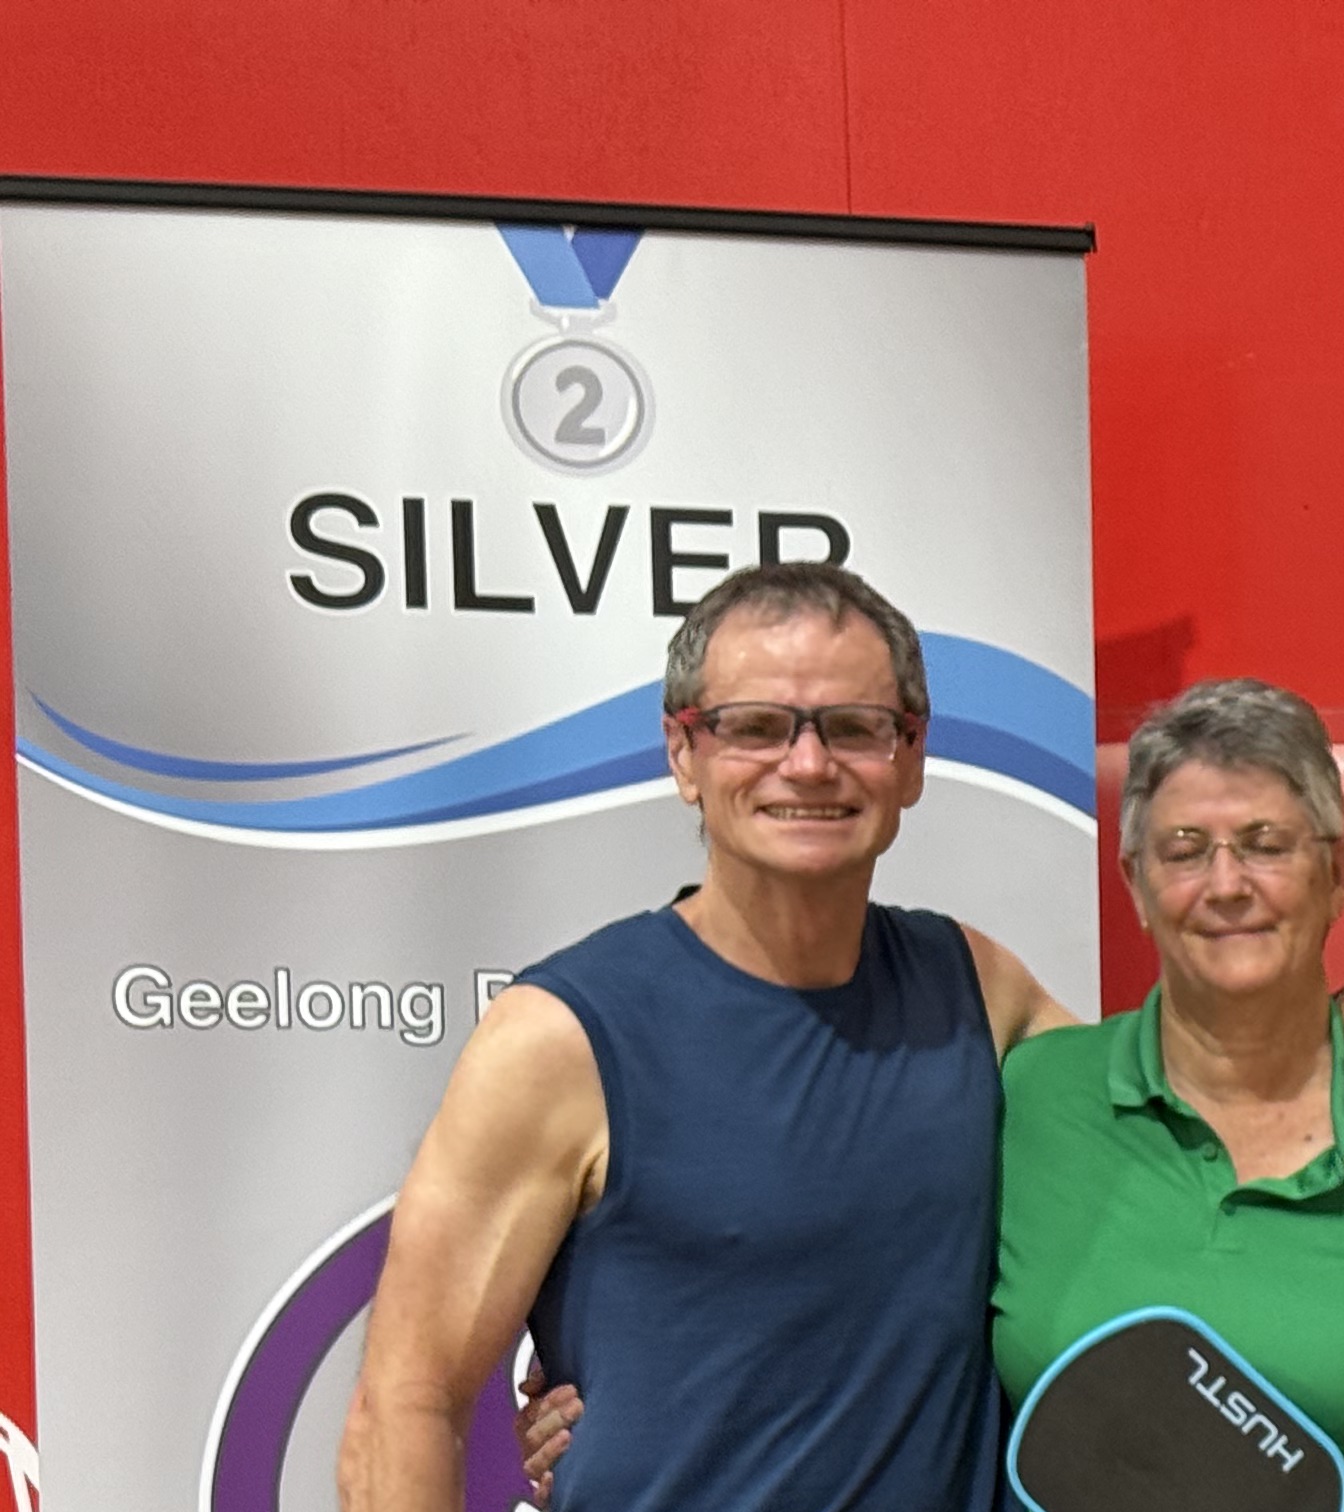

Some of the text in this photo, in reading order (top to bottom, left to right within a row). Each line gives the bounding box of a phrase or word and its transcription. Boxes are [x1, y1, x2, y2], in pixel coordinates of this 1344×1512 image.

[554, 364, 606, 445] 2
[112, 964, 446, 1047] Geelong
[1187, 1346, 1305, 1474] HUSTL
